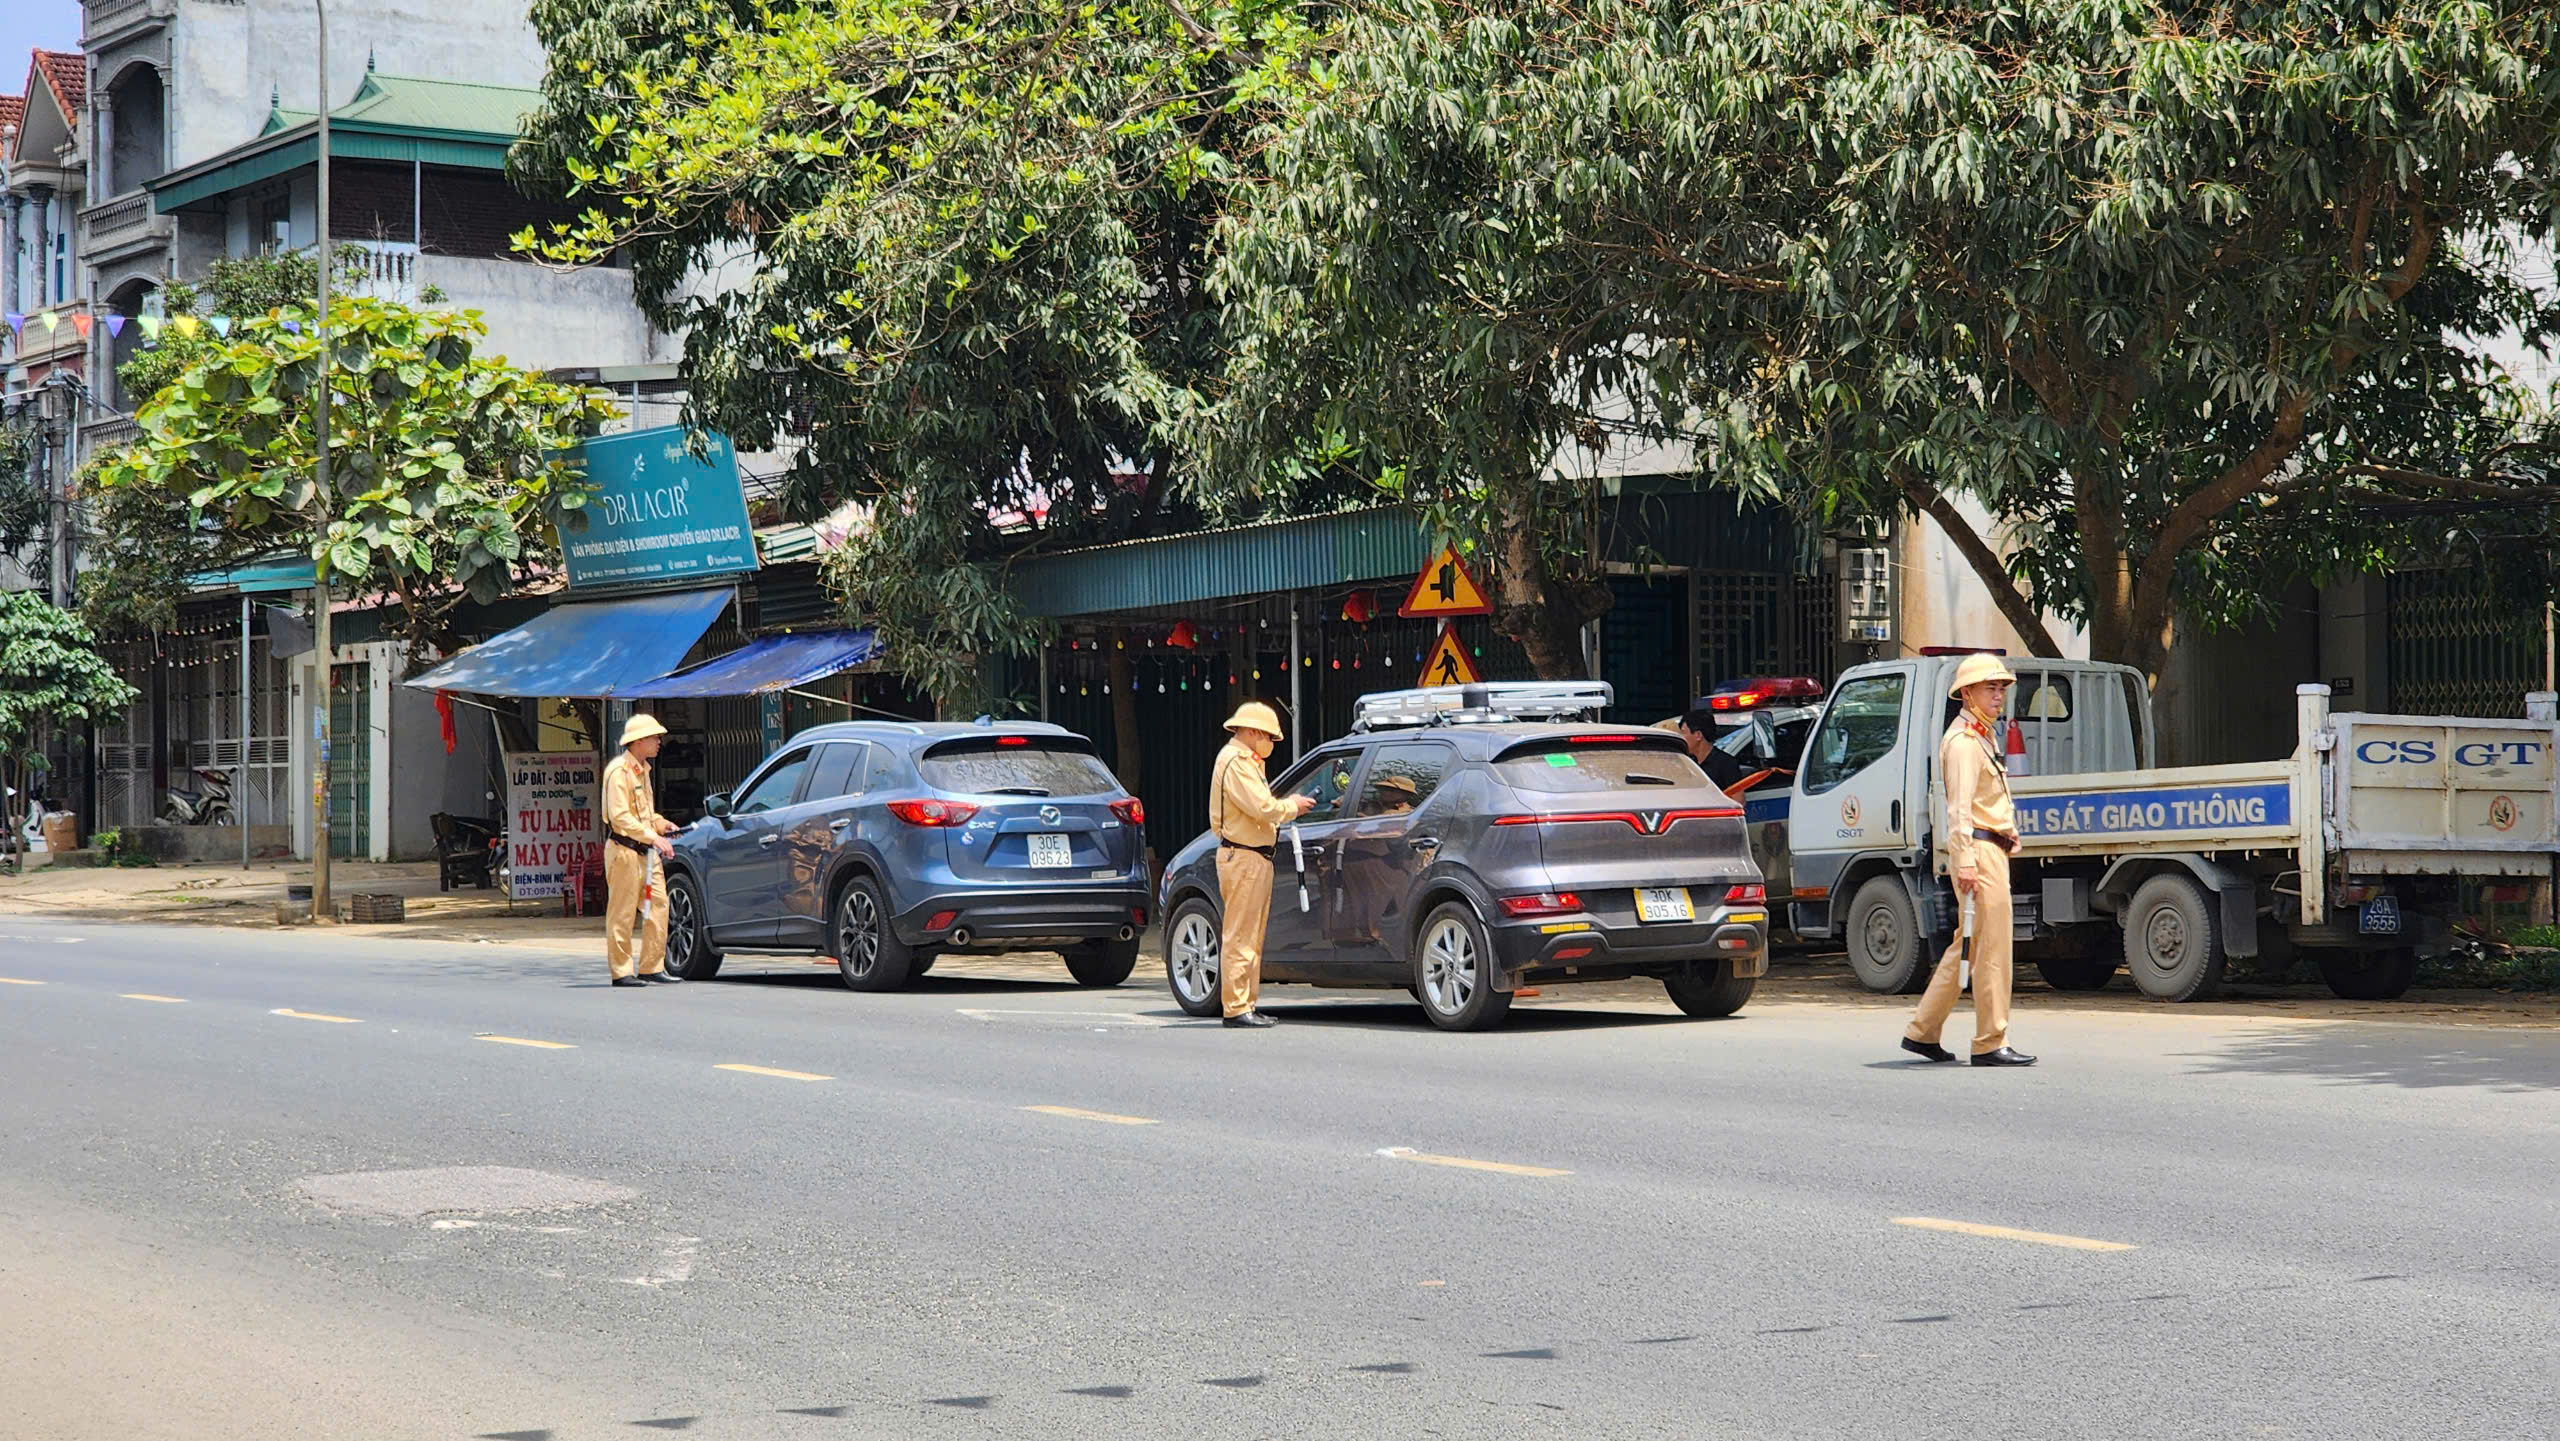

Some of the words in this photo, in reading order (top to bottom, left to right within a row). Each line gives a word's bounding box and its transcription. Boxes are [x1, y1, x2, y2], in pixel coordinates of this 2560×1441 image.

[519, 801, 541, 833] TỦ
[546, 808, 591, 837] LẠNH
[2045, 800, 2094, 832] SÁT
[2101, 802, 2165, 829] GIAO
[2171, 793, 2265, 826] THÔNG
[1836, 828, 1864, 838] CSGT
[1039, 836, 1060, 850] 30E
[515, 837, 551, 867] MÁY
[1650, 890, 1675, 902] 30K
[1645, 904, 1688, 918] 905.16
[2370, 899, 2391, 914] 28A
[2366, 915, 2396, 931] 3555
